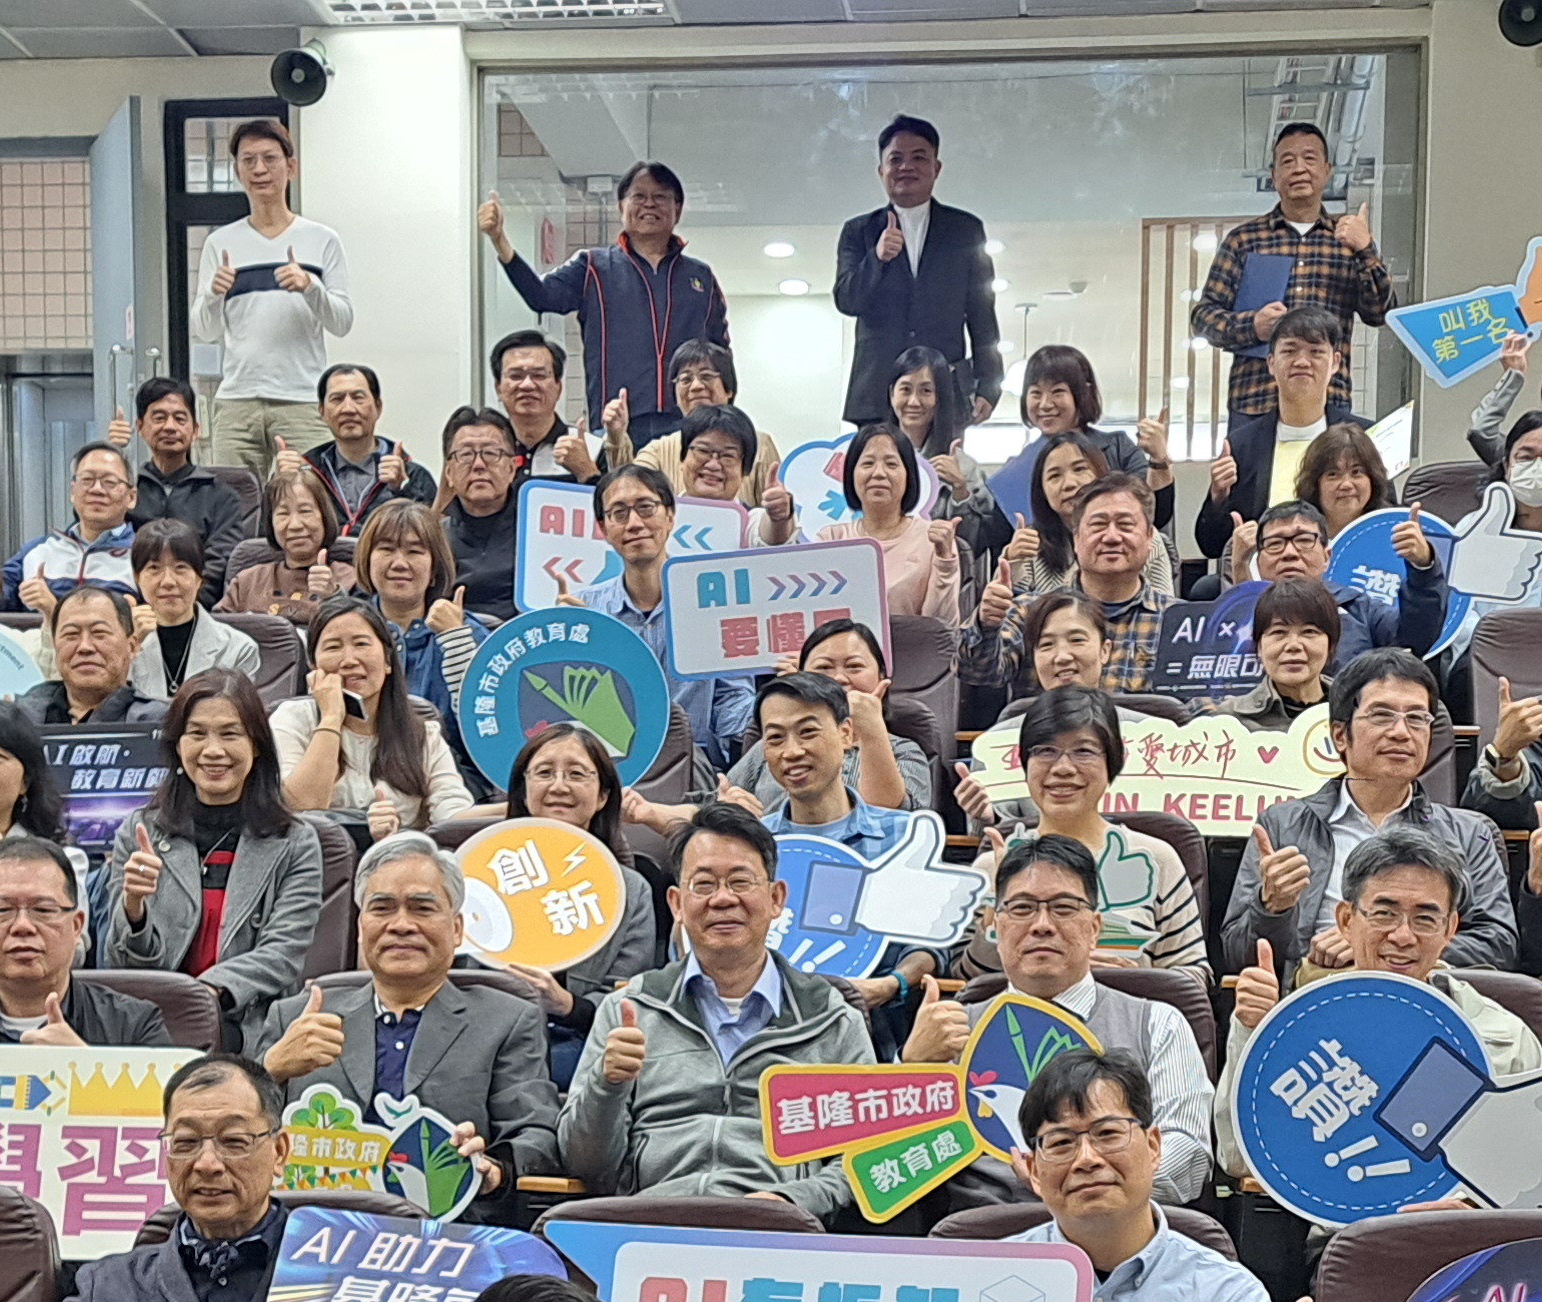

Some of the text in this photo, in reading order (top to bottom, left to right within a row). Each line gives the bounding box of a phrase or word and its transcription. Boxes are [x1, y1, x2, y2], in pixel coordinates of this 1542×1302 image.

[1438, 298, 1493, 333] 叫我
[1431, 316, 1510, 364] 第一名
[697, 568, 751, 608] AI
[1171, 615, 1206, 643] AI
[776, 1079, 955, 1136] 基隆市政府
[869, 1130, 963, 1194] 教育處
[290, 1226, 475, 1278] AI 助力
